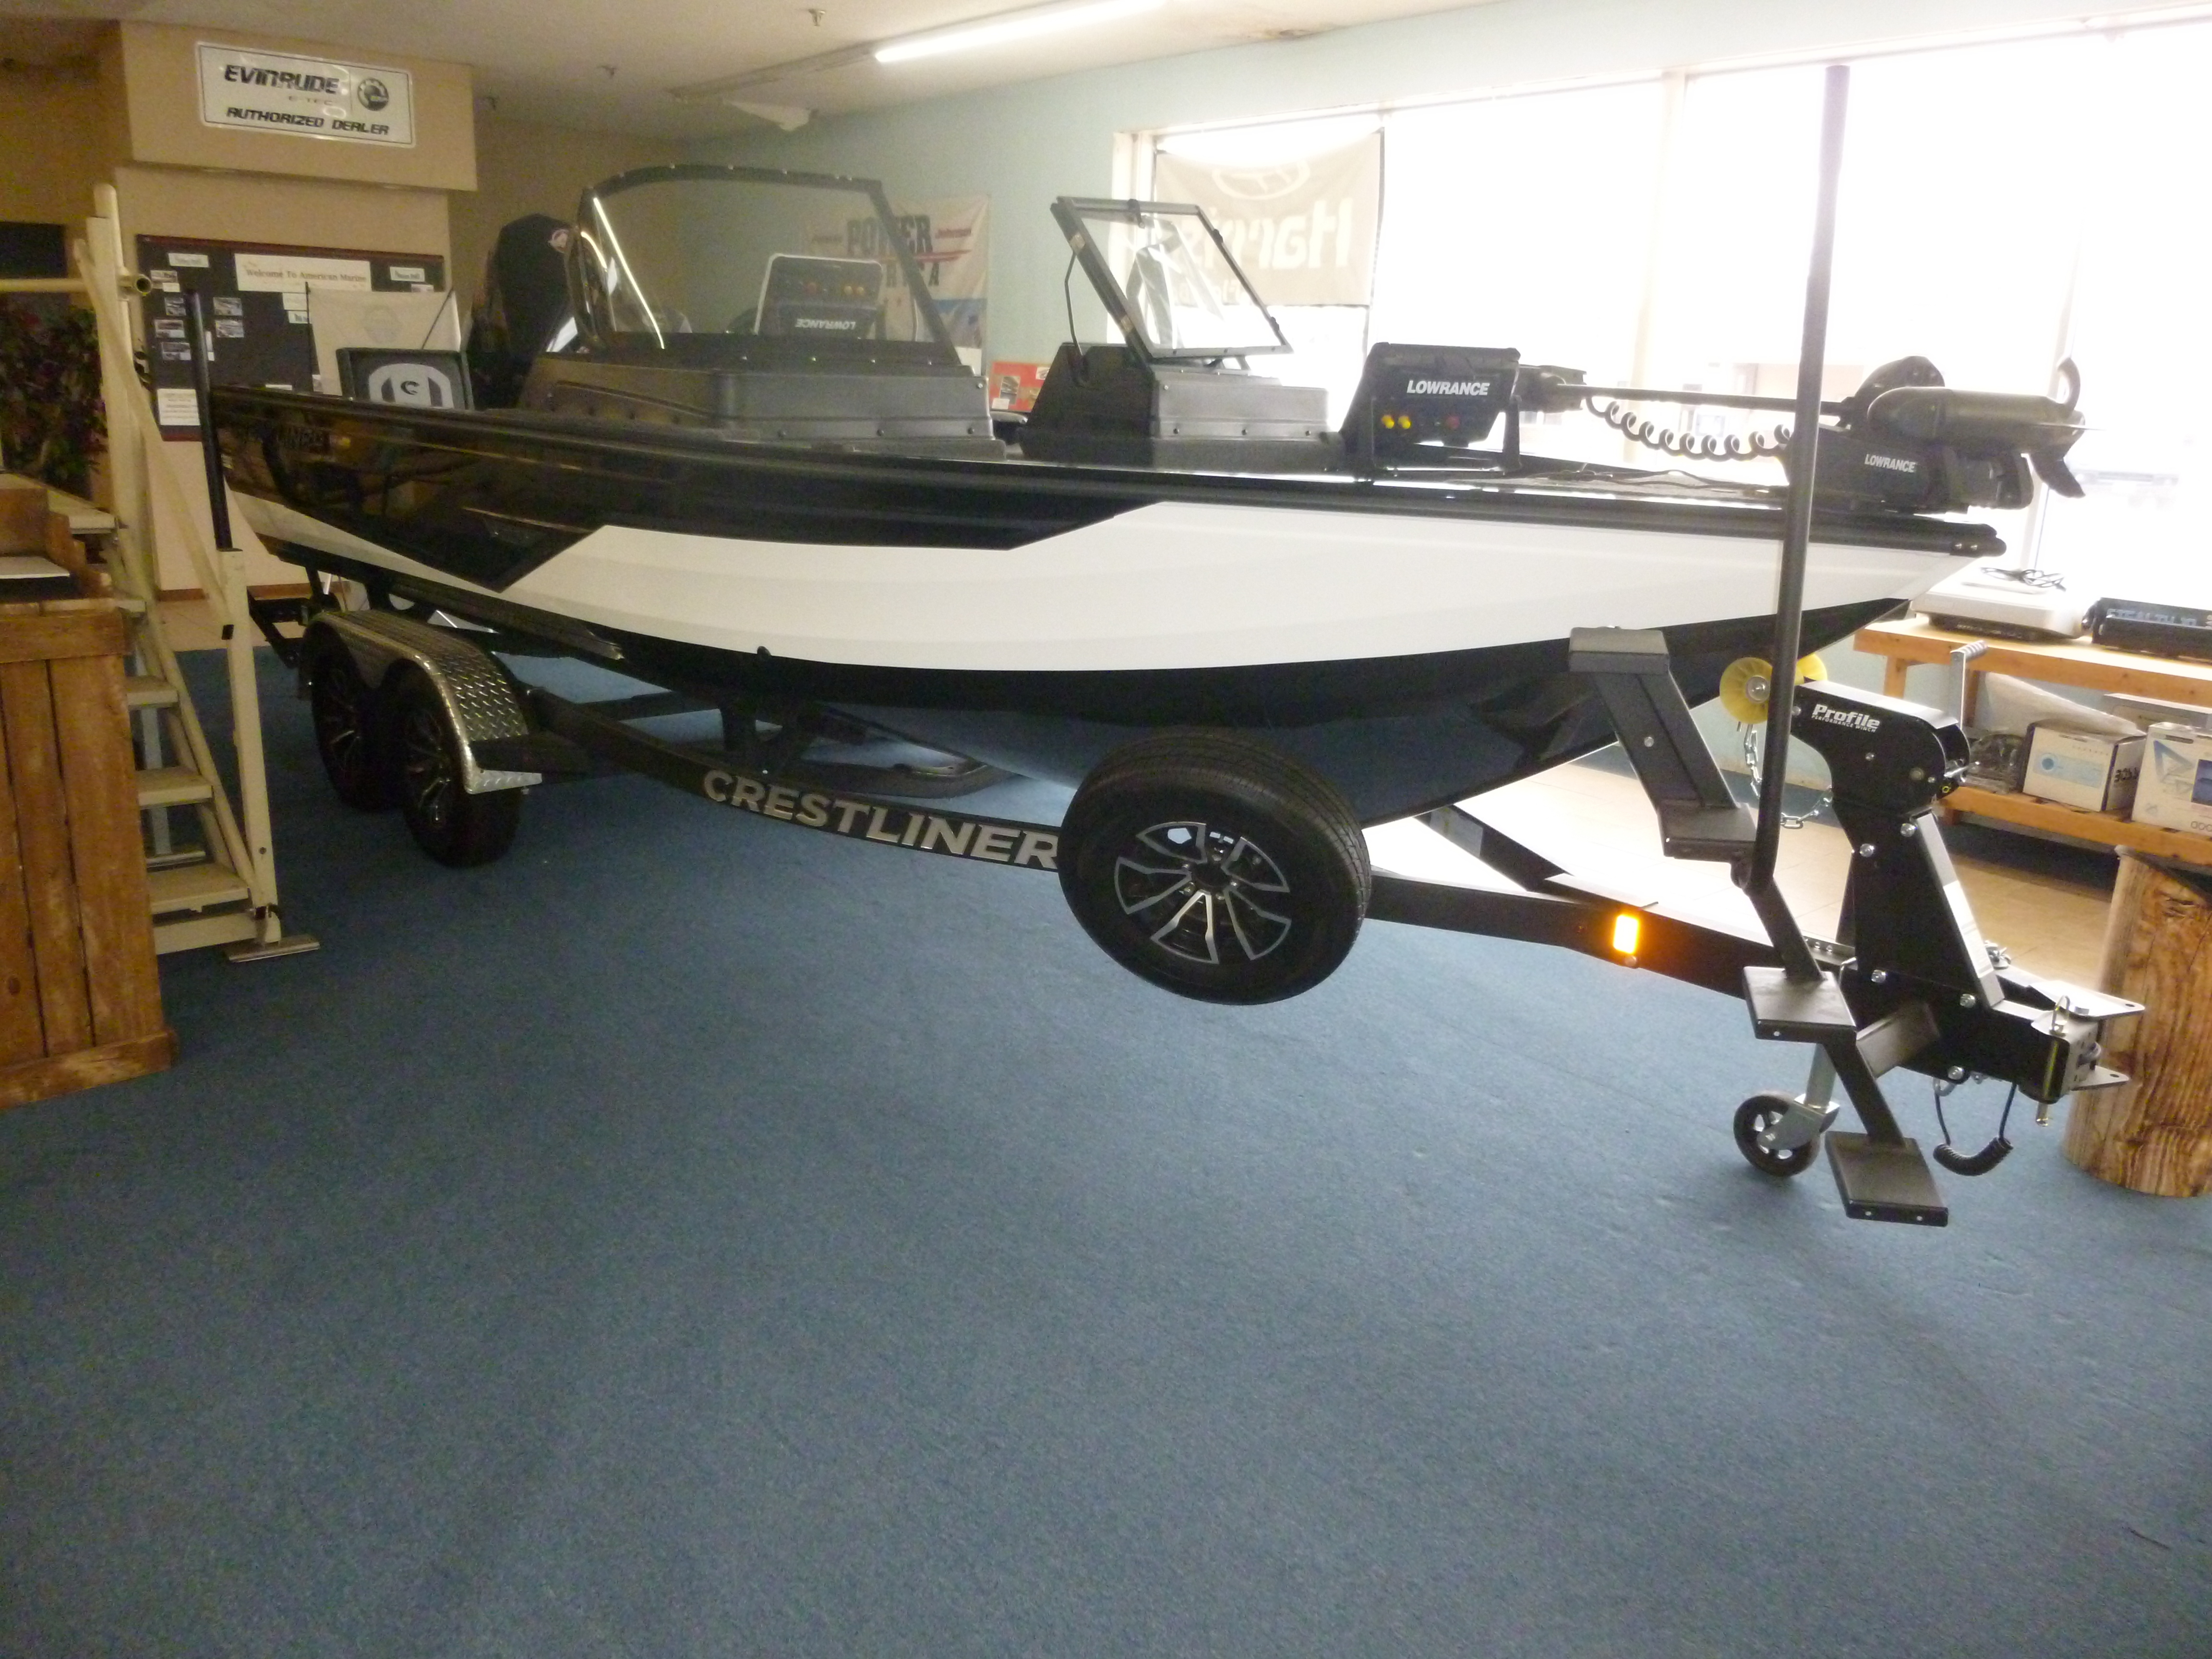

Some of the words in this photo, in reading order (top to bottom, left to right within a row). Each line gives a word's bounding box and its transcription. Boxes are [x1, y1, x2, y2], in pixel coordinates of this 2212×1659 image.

[225, 64, 339, 94] EVINRUDE
[226, 107, 325, 128] AUTHORIZED
[332, 119, 389, 135] DEALER
[246, 269, 284, 278] Welcome
[287, 270, 297, 278] To
[300, 272, 337, 281] American
[340, 274, 367, 282] Marine
[795, 318, 856, 330] LOWRANCE
[1407, 380, 1490, 396] LOWRANCE
[1864, 454, 1916, 473] LOWRANCE
[1811, 715, 1854, 728] PERFORMANCE
[1855, 724, 1876, 733] WINCH
[1812, 704, 1880, 729] Profile
[703, 769, 1058, 870] CRESTLINER
